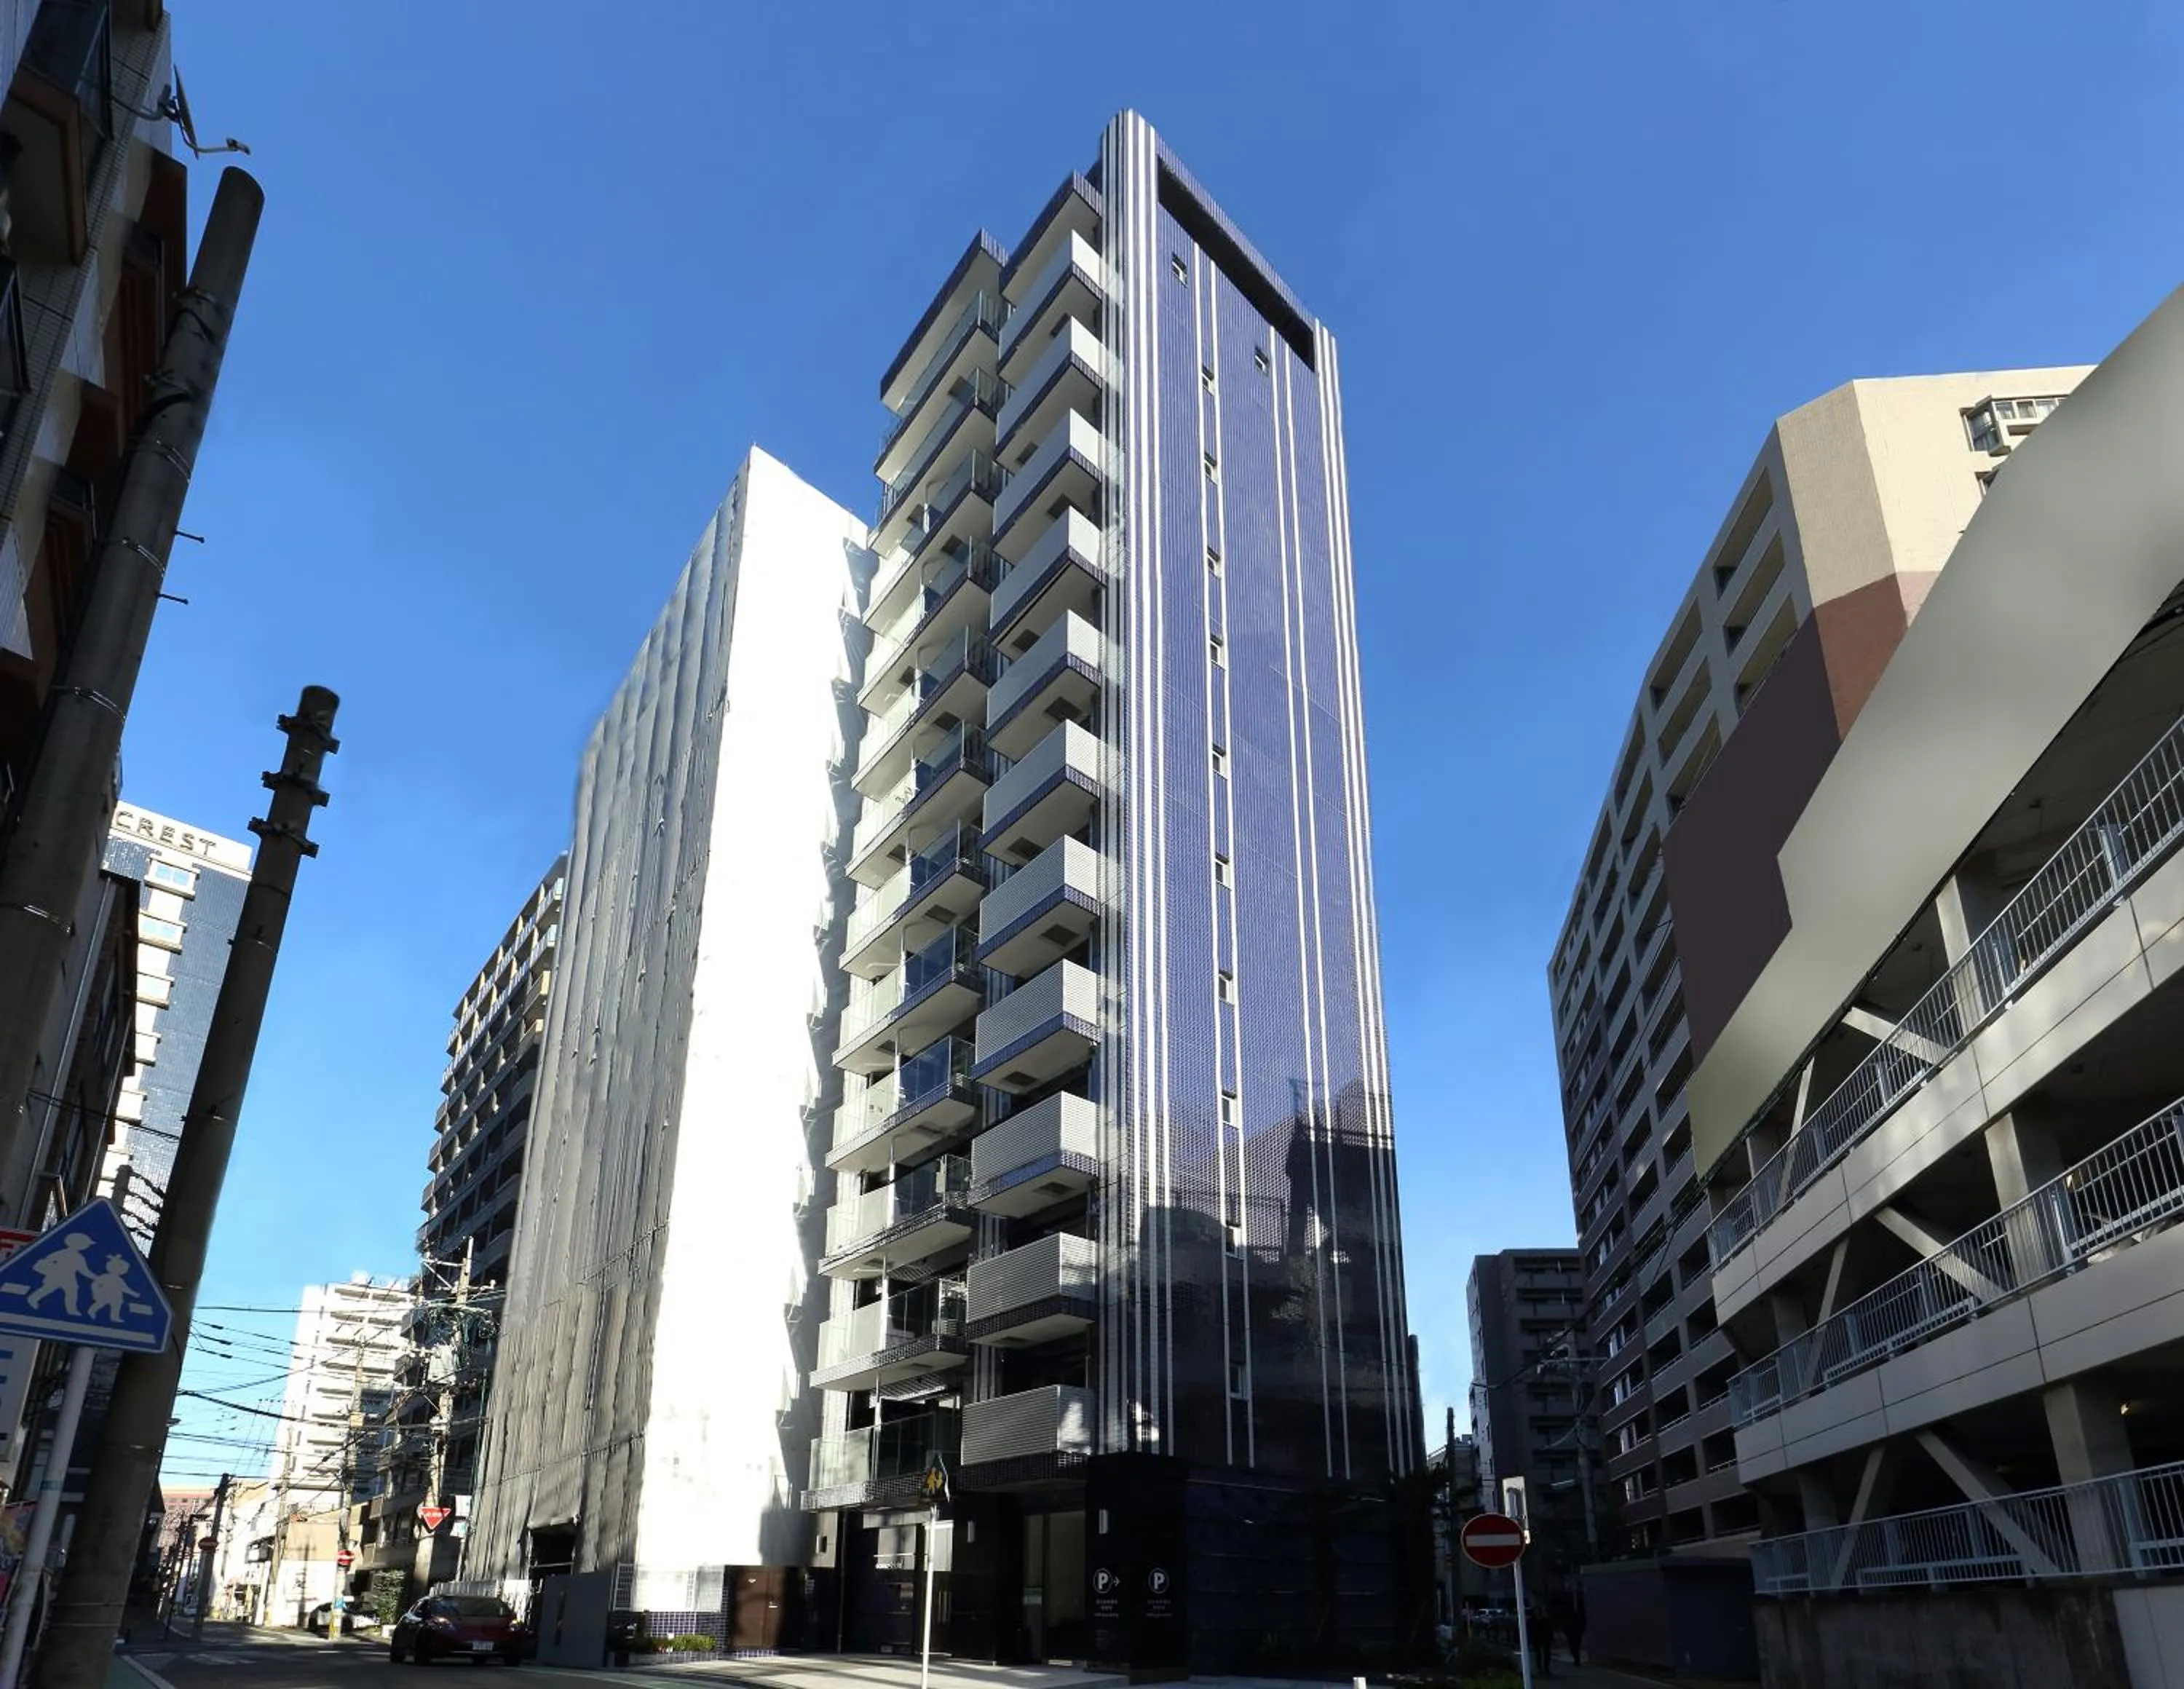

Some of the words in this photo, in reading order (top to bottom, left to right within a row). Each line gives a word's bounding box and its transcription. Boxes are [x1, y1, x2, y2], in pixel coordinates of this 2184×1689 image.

[115, 810, 217, 856] CREST
[1098, 1572, 1109, 1590] P
[1153, 1572, 1166, 1590] P
